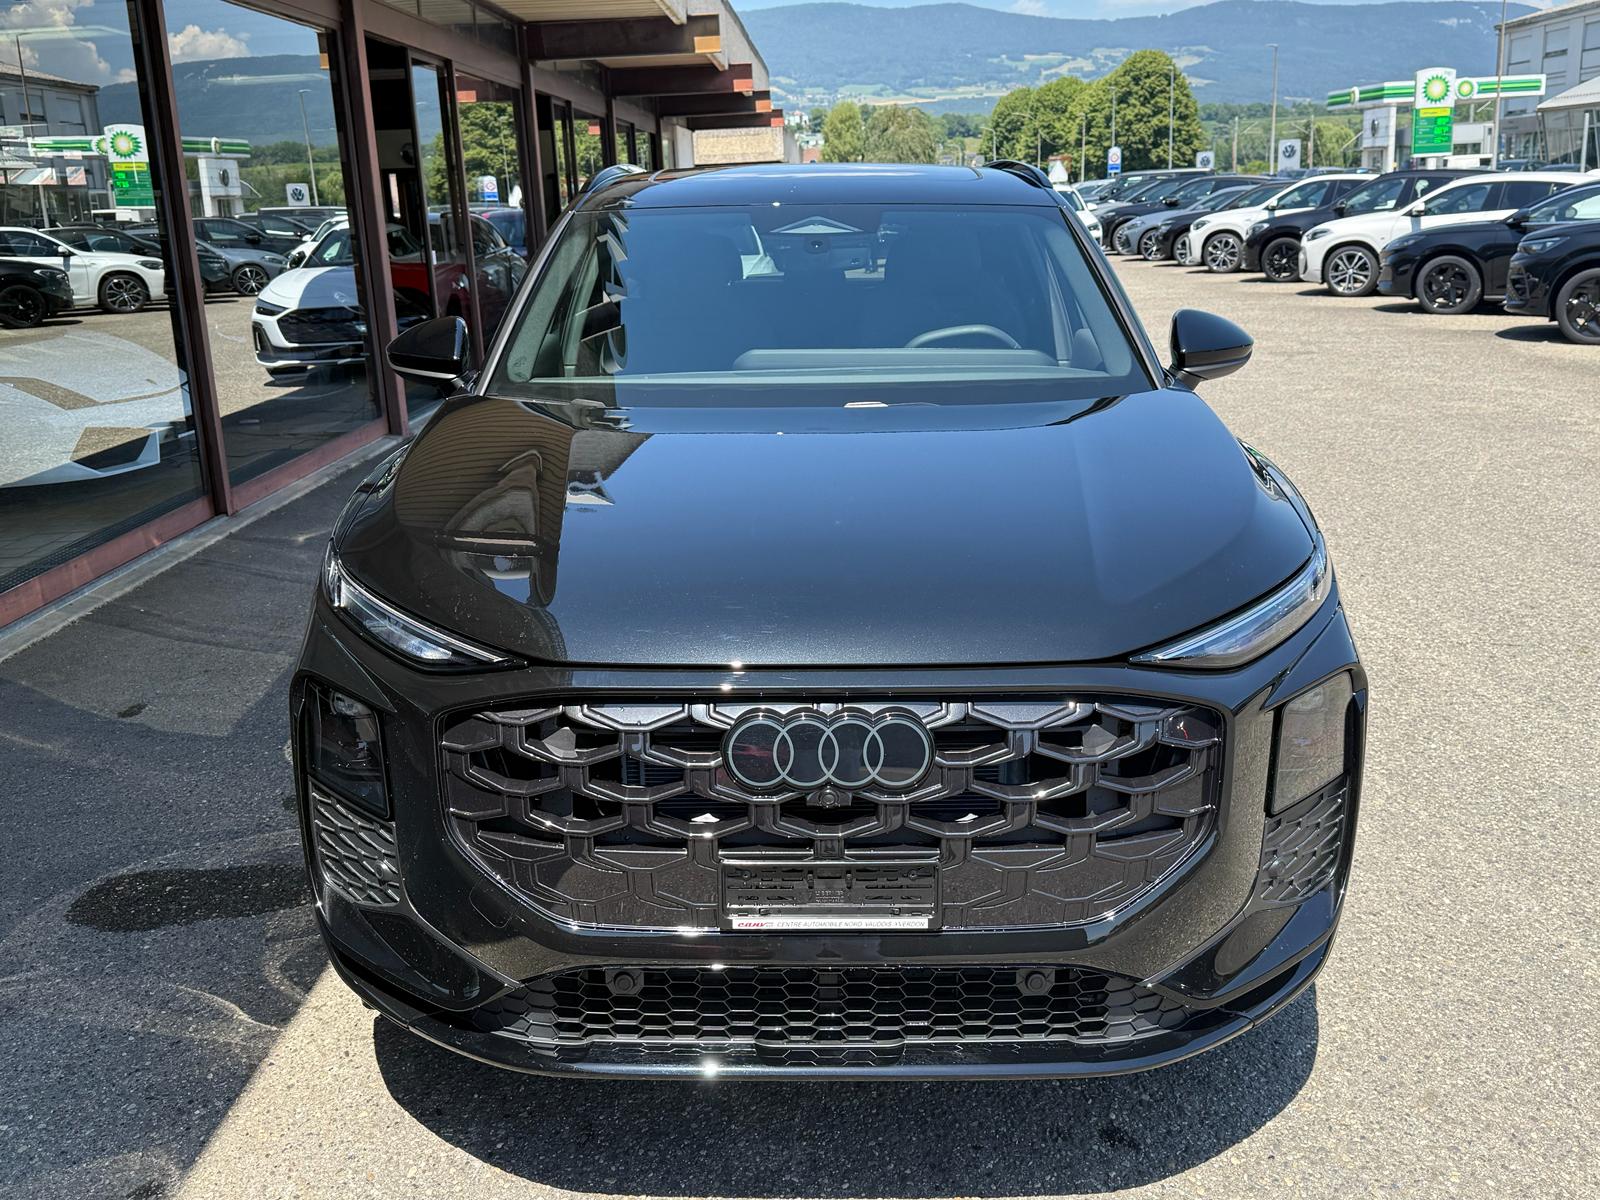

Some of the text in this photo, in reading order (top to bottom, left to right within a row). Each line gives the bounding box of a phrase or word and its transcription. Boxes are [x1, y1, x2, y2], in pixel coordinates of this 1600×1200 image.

[776, 920, 803, 928] CENTRE
[803, 920, 843, 928] AUTOMOBILE
[844, 920, 863, 928] NORD
[865, 920, 892, 928] VAUDOIS
